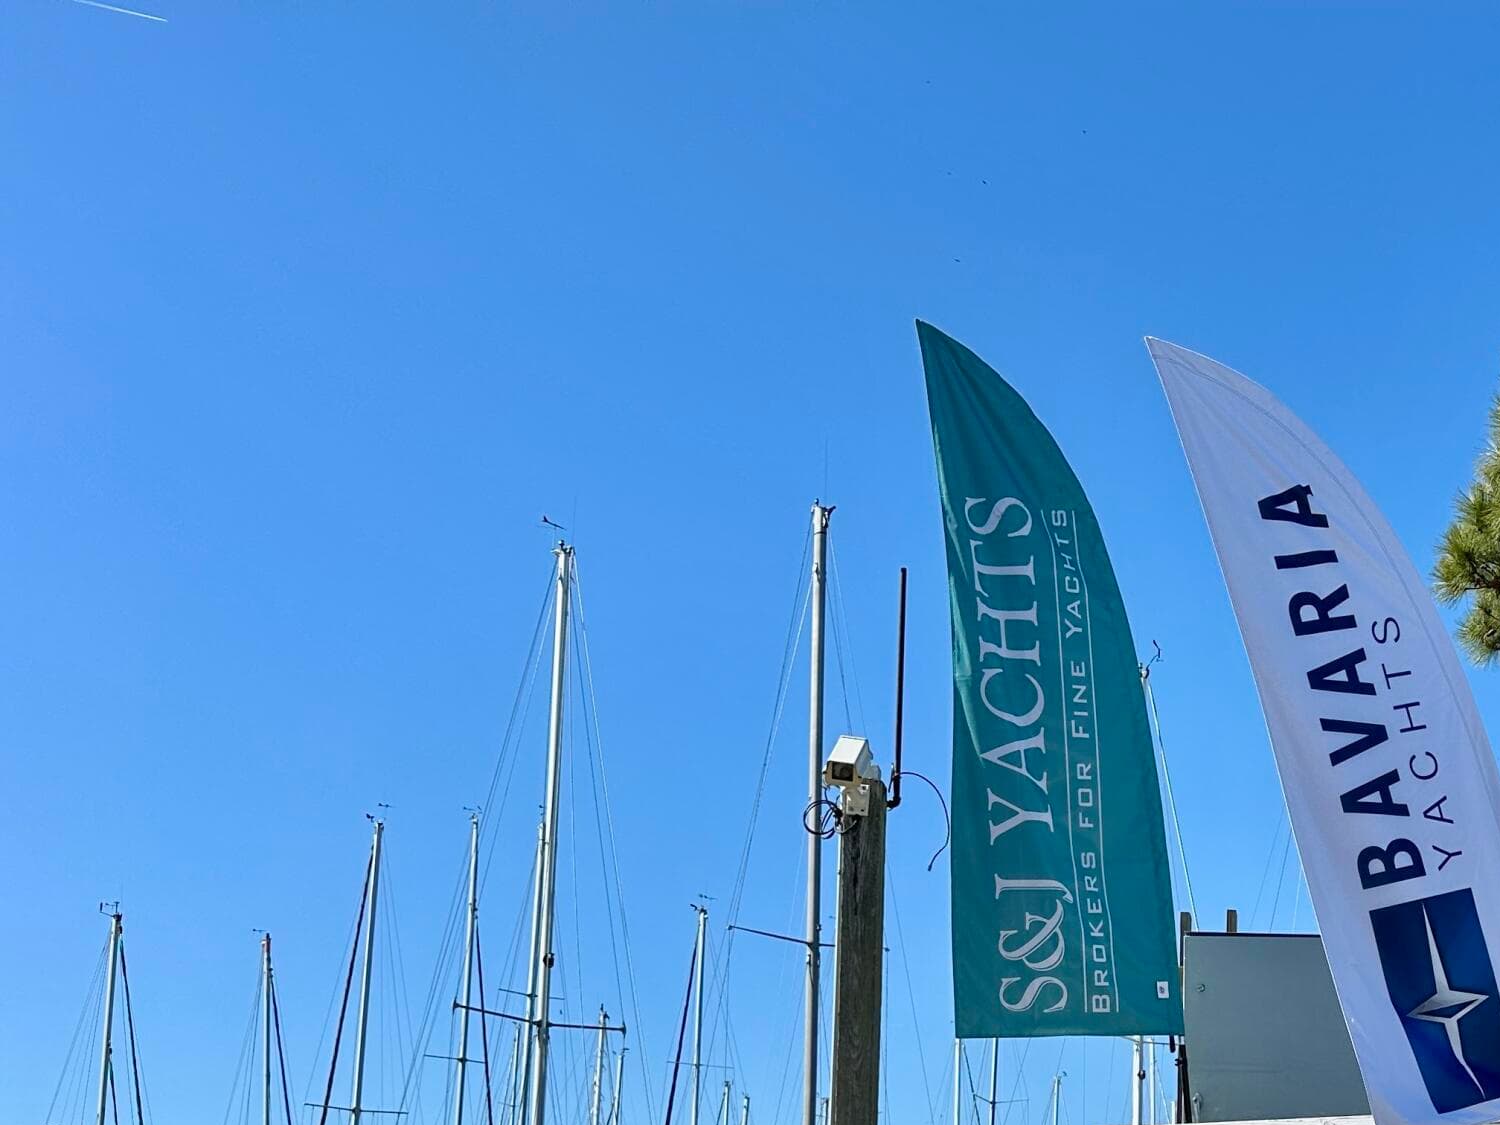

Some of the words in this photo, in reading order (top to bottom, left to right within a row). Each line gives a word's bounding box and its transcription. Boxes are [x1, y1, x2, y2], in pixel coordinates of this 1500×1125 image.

[1051, 510, 1083, 638] YACHTS
[965, 497, 1054, 845] YACHTS
[1070, 660, 1090, 739] FINE
[1257, 483, 1427, 890] BAVARIA
[1371, 616, 1463, 872] YACHTS
[1077, 763, 1094, 828] FOR
[995, 873, 1073, 1013] S&J
[1080, 851, 1111, 1013] BROKERS
